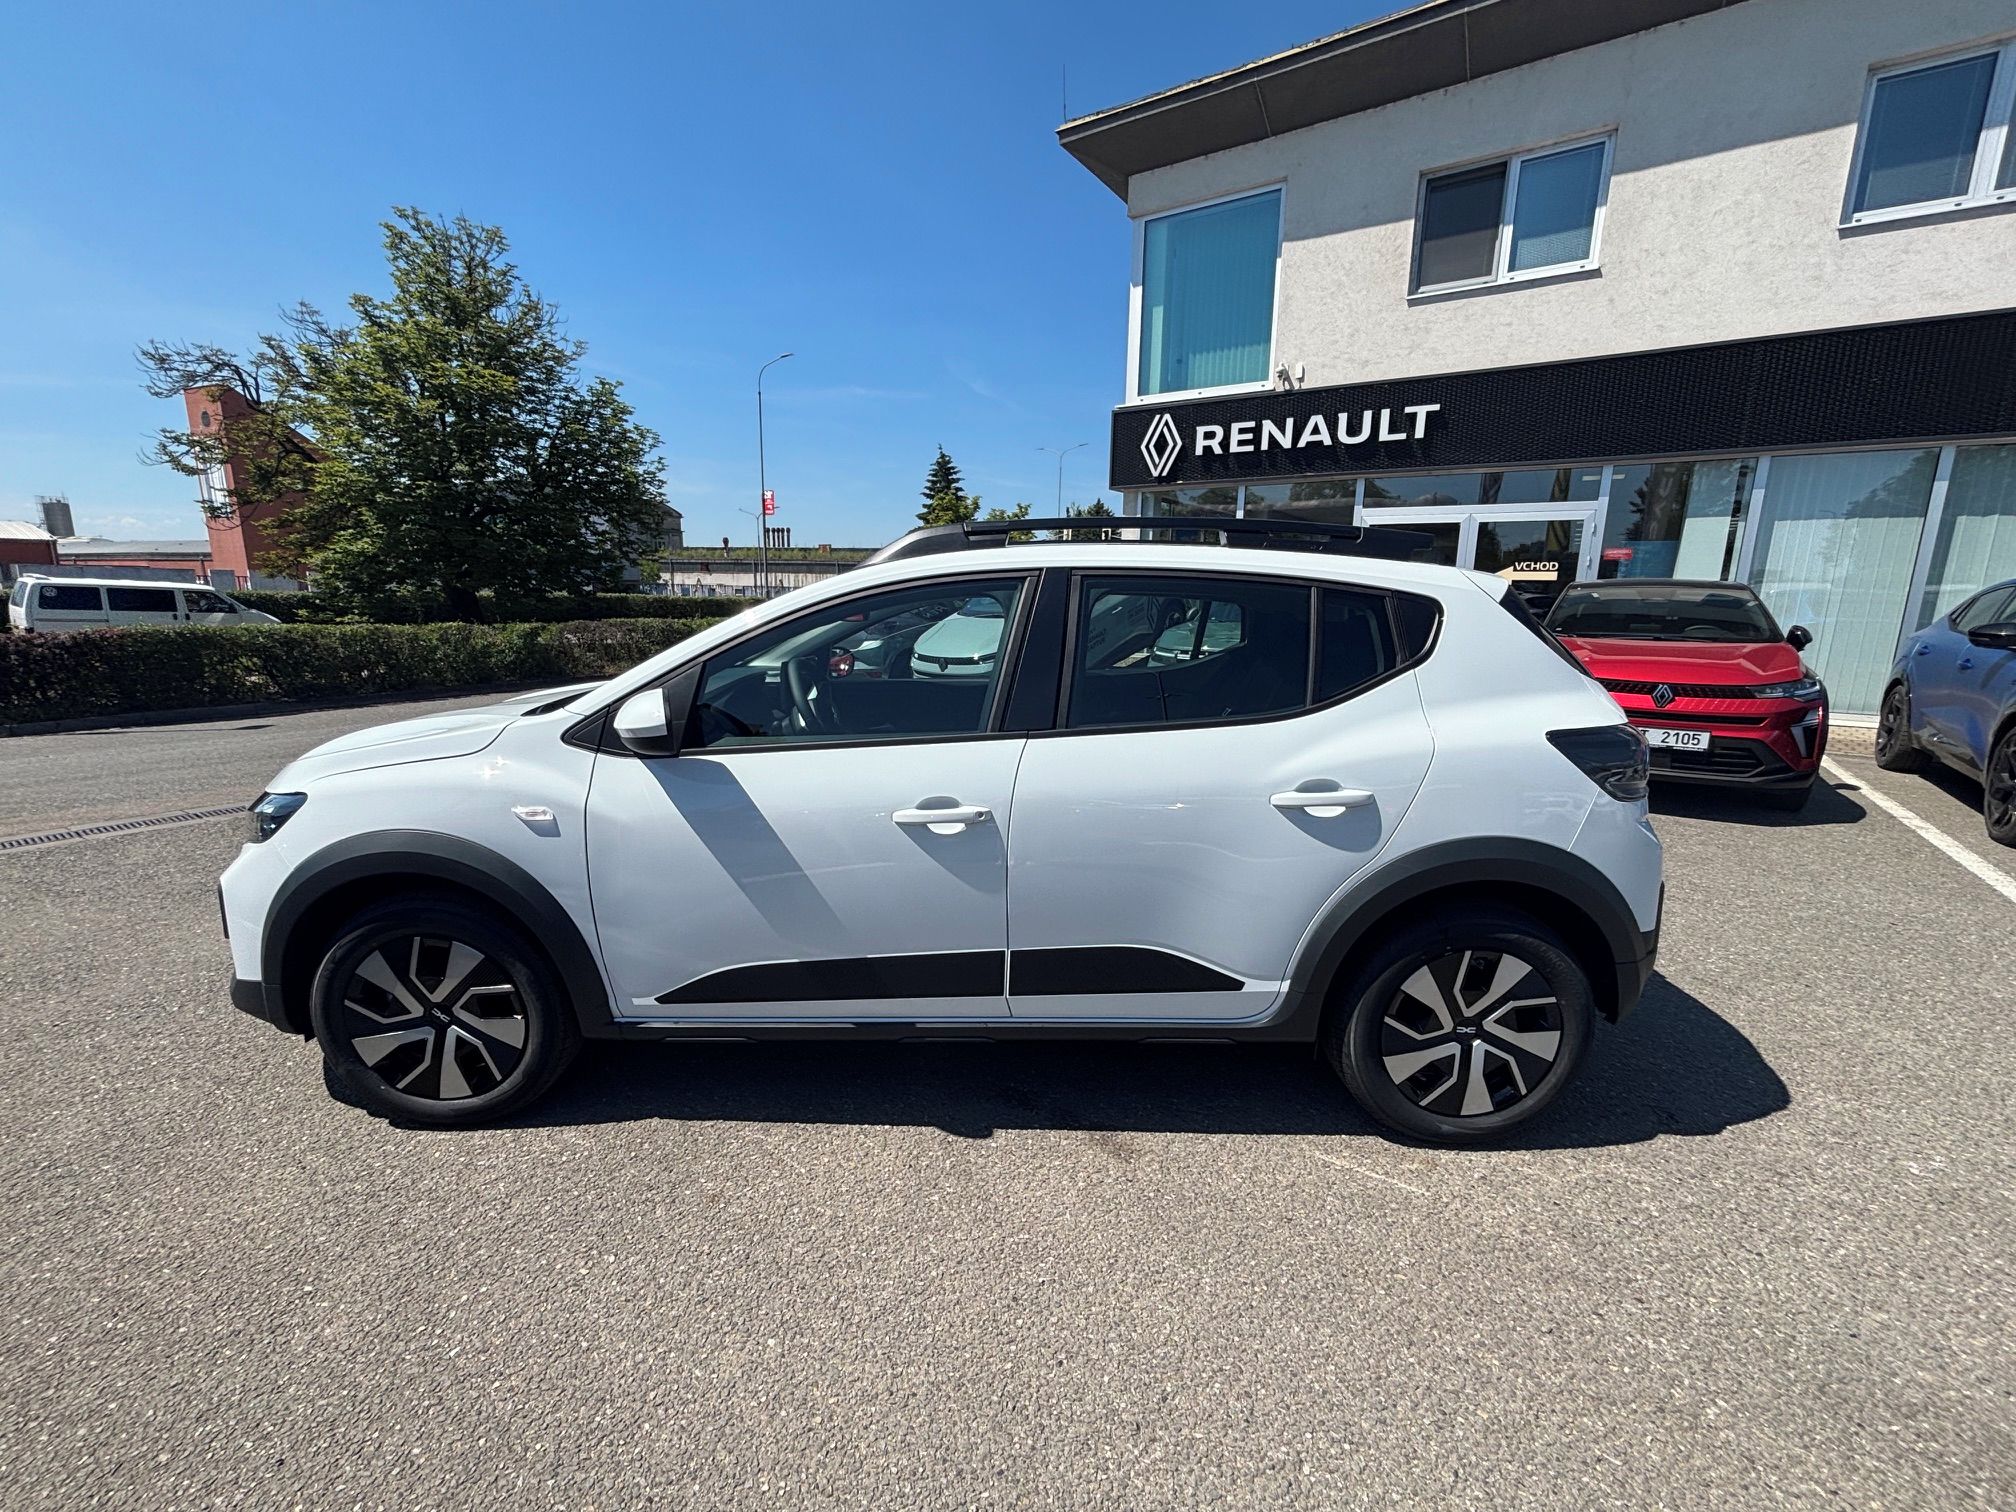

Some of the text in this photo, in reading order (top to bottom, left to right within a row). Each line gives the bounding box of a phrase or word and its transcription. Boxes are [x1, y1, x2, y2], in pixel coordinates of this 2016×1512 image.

[1195, 404, 1441, 456] RENAULT
[1515, 561, 1559, 571] VCHOD
[1660, 731, 1702, 746] 2105
